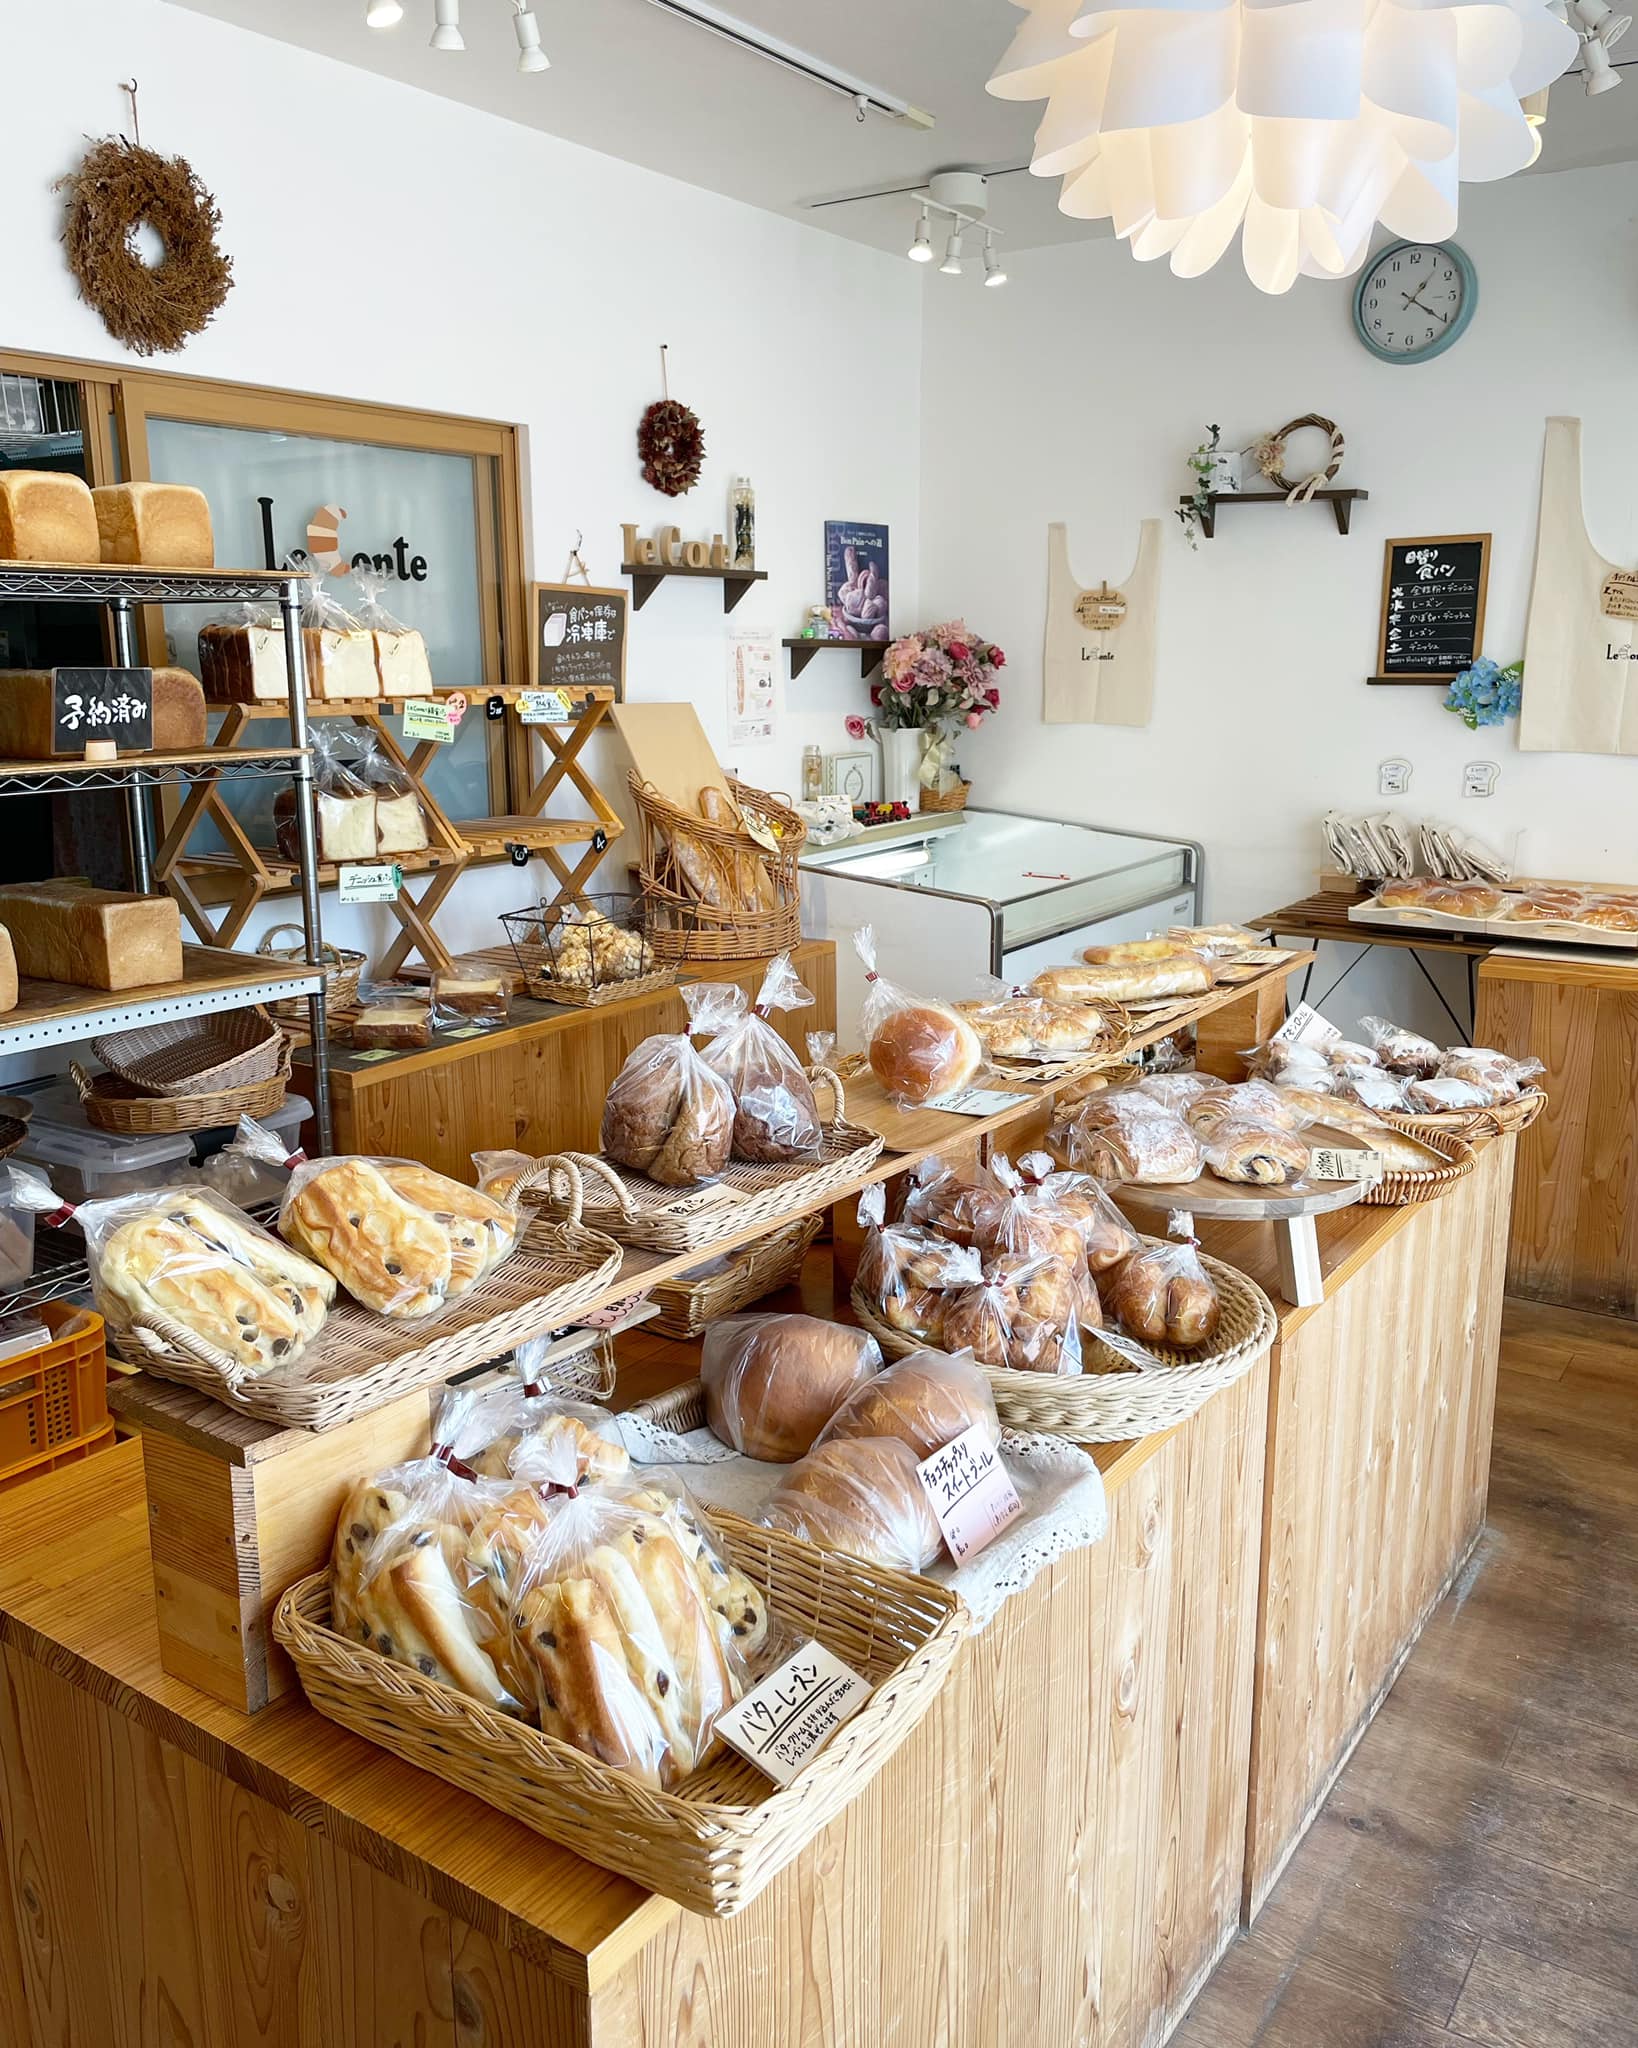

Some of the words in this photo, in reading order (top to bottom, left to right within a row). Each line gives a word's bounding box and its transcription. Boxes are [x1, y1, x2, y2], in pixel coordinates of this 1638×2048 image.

[1410, 252, 1421, 264] 12
[1433, 257, 1437, 268] 1
[1392, 261, 1400, 272] 11
[1444, 270, 1453, 281] 2
[1375, 279, 1386, 289] 10
[1369, 299, 1378, 309] 9
[1373, 319, 1382, 329] 8
[1387, 332, 1394, 343] 7
[1425, 328, 1434, 338] 5
[1405, 335, 1414, 345] 6
[1415, 563, 1456, 580] 食パン
[1391, 586, 1404, 598] 火
[1389, 600, 1405, 611] 水
[1412, 597, 1444, 609] レーズン
[1389, 612, 1402, 626] 木
[566, 618, 616, 644] 冷凍庫で
[1388, 627, 1402, 640] 金
[1409, 627, 1436, 638] レーズン
[1386, 642, 1402, 653] 土
[1408, 641, 1440, 652] デニッシュ
[60, 693, 147, 730] 予約済み
[942, 1451, 994, 1501] スイートブール
[739, 1664, 818, 1746] バターレーズン
